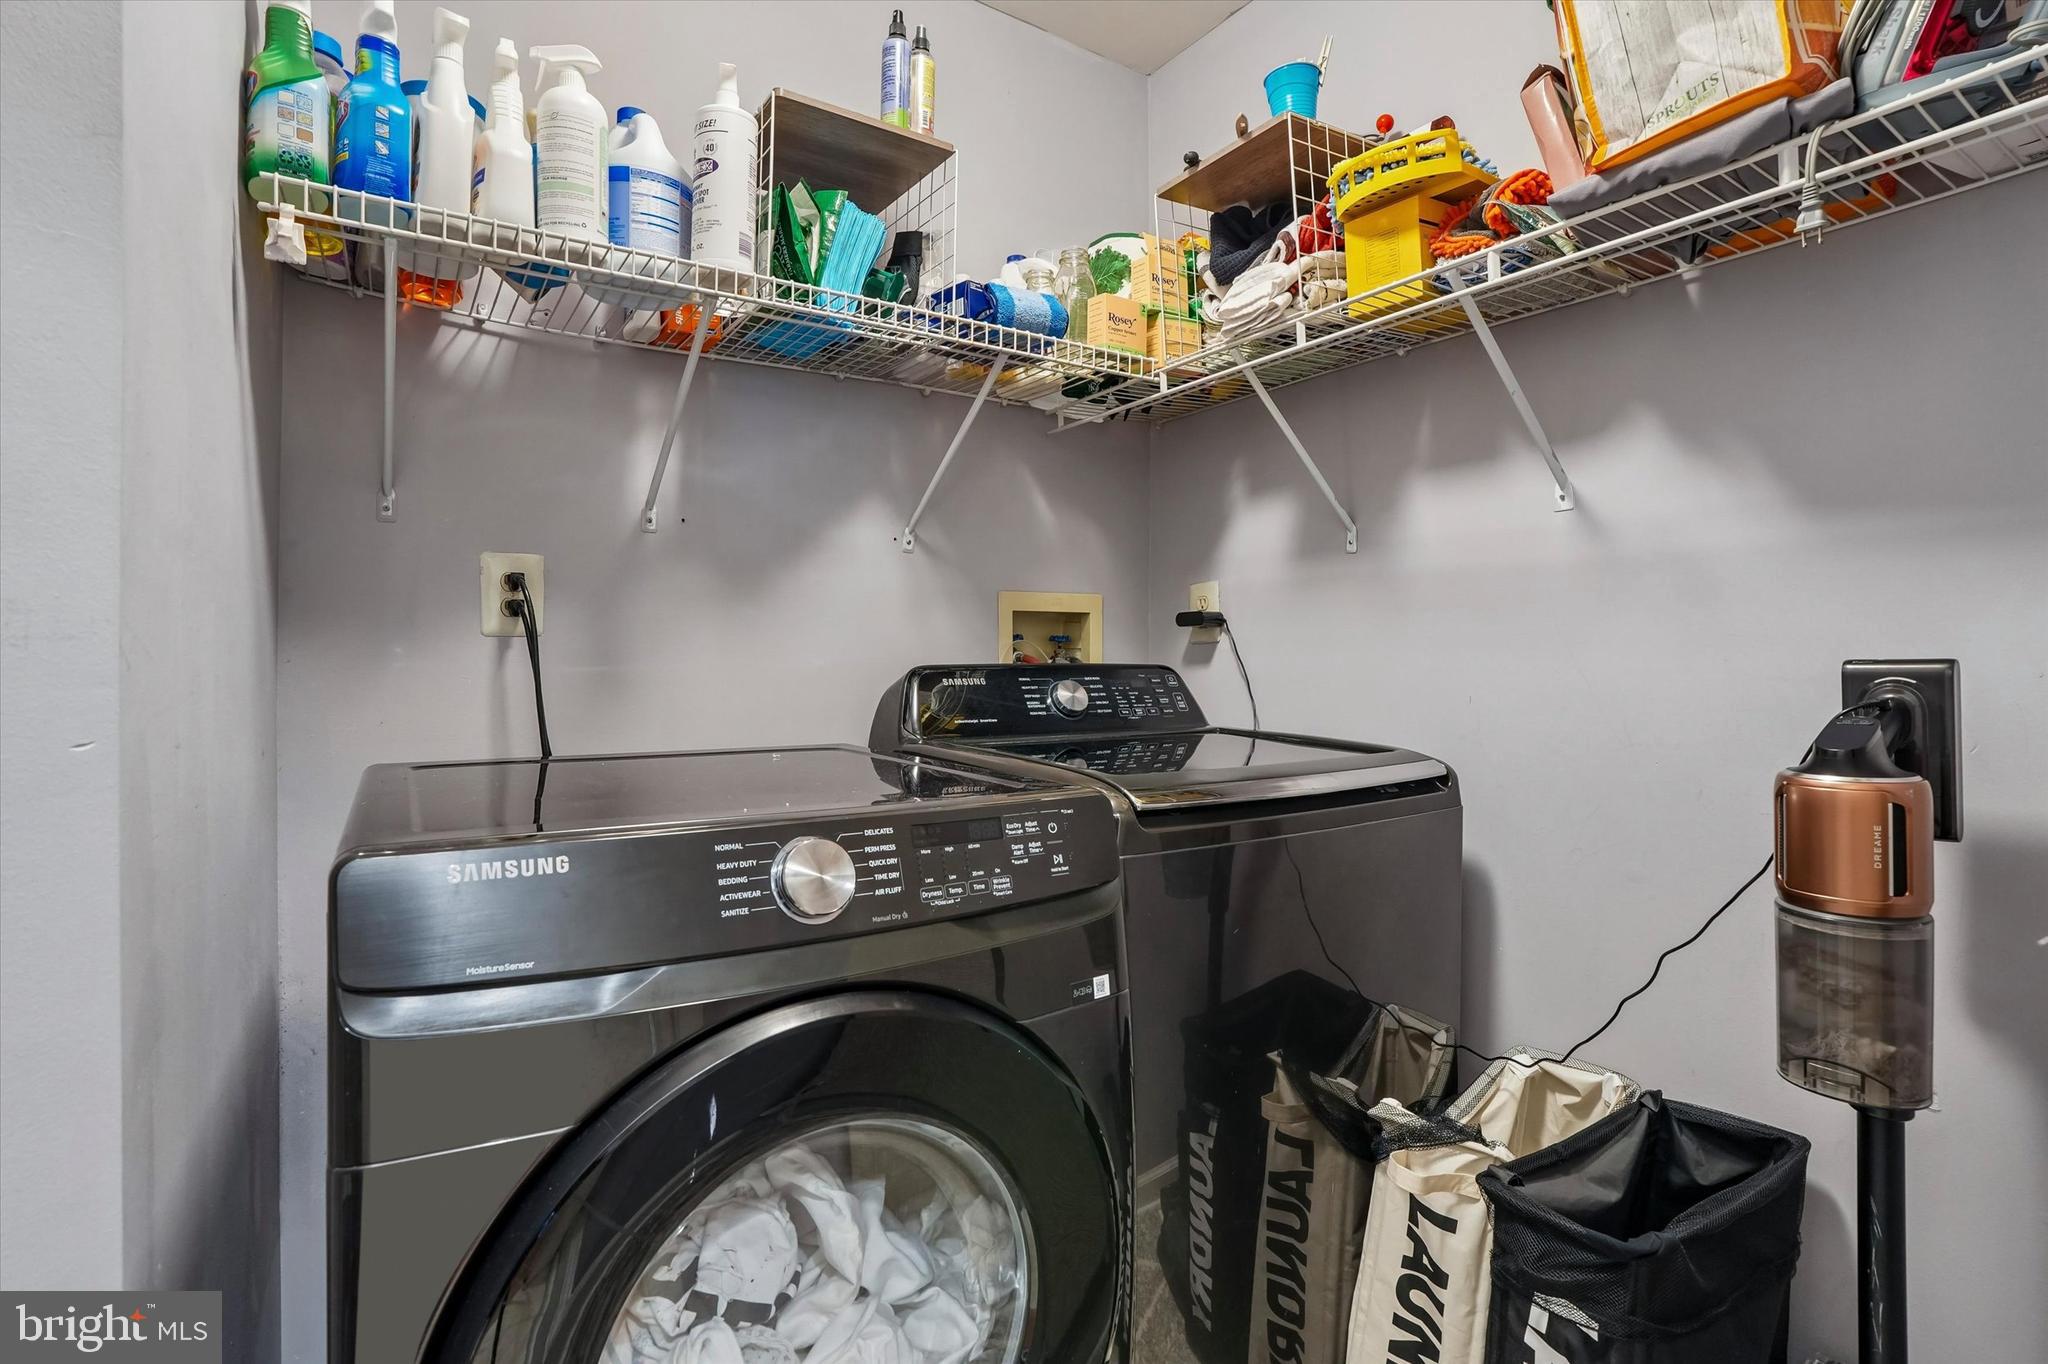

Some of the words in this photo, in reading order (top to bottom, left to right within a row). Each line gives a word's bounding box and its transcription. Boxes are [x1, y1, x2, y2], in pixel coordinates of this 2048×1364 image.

[1872, 7, 1903, 55] Shark
[1647, 71, 1720, 129] SPROUTS
[705, 143, 715, 152] 40
[1108, 312, 1137, 328] Rosey
[942, 678, 986, 686] SAMSUNG
[864, 827, 894, 836] DELICATES
[714, 843, 743, 852] NORMAL
[864, 845, 879, 853] PERM
[879, 844, 896, 852] PRESS
[1873, 825, 1882, 869] DREAME
[716, 861, 738, 871] HEAVY
[739, 859, 757, 868] DUTY
[868, 859, 884, 867] QUICK
[884, 857, 898, 865] DRY
[447, 855, 570, 884] SAMSUNG
[718, 876, 748, 886] BEDDING
[874, 873, 887, 881] TIME
[887, 871, 900, 880] DRY
[719, 890, 761, 901] ACTIVEWEAR
[874, 888, 885, 896] AIR
[885, 886, 902, 895] FLUFF
[922, 890, 942, 898] Dryness
[720, 907, 749, 917] SANITIZE
[872, 914, 891, 923] Manual
[891, 913, 901, 922] Dry
[466, 961, 535, 976] MoistureSensor
